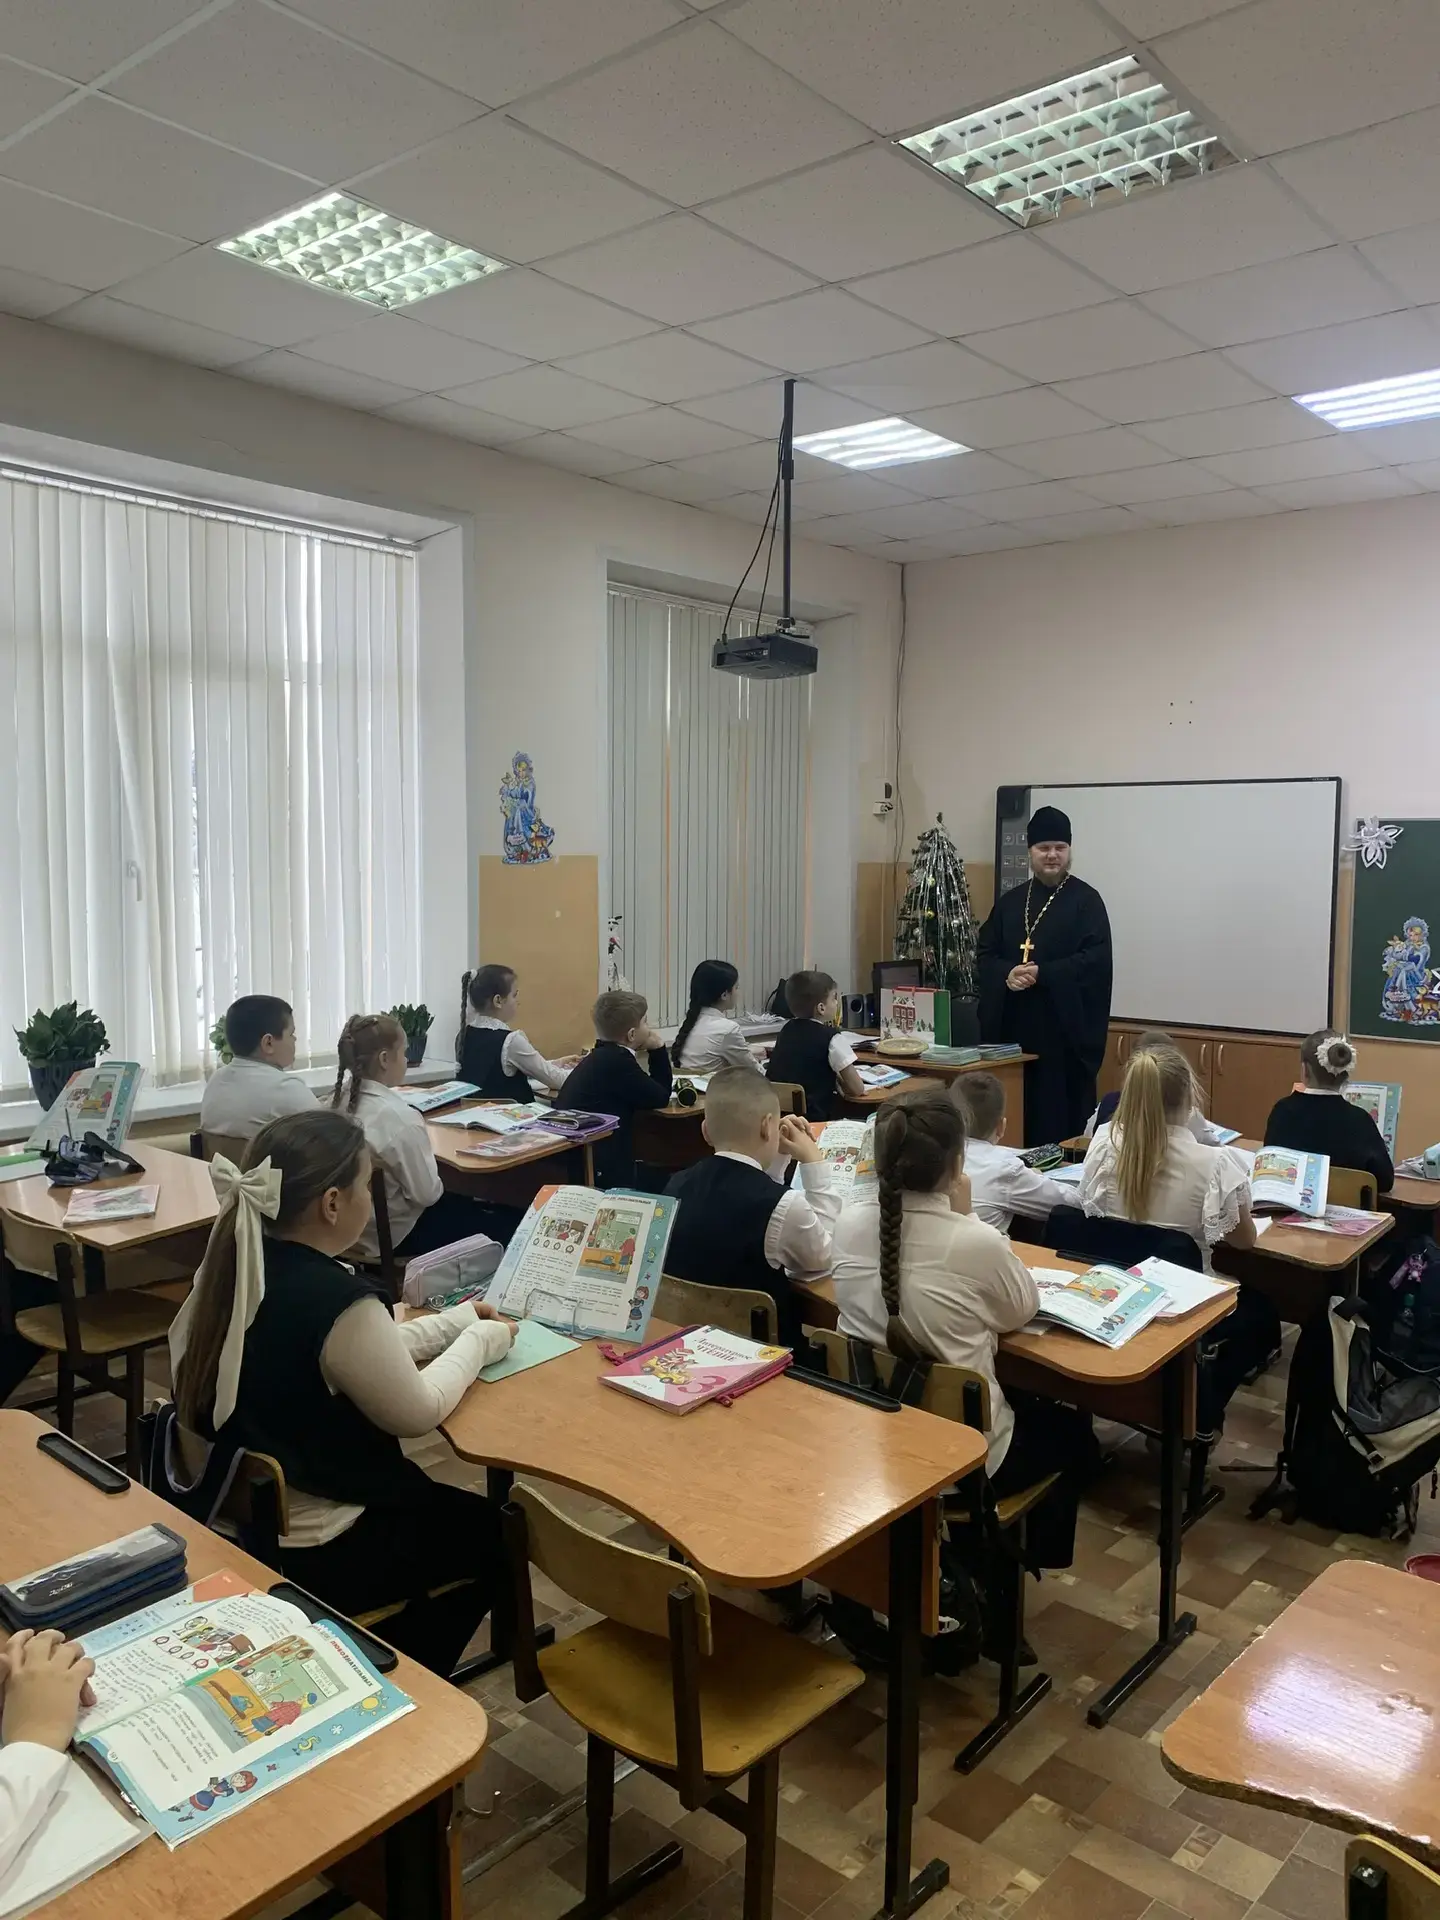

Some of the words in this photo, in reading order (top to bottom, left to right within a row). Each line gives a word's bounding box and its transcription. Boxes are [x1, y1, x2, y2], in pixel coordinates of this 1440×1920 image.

[694, 1337, 752, 1360] Литературное
[697, 1344, 736, 1361] ЧТЕНИЕ
[677, 1375, 727, 1394] 3
[330, 1640, 374, 1688] ЛЮБОЗНАТЕЛЬНЫХ
